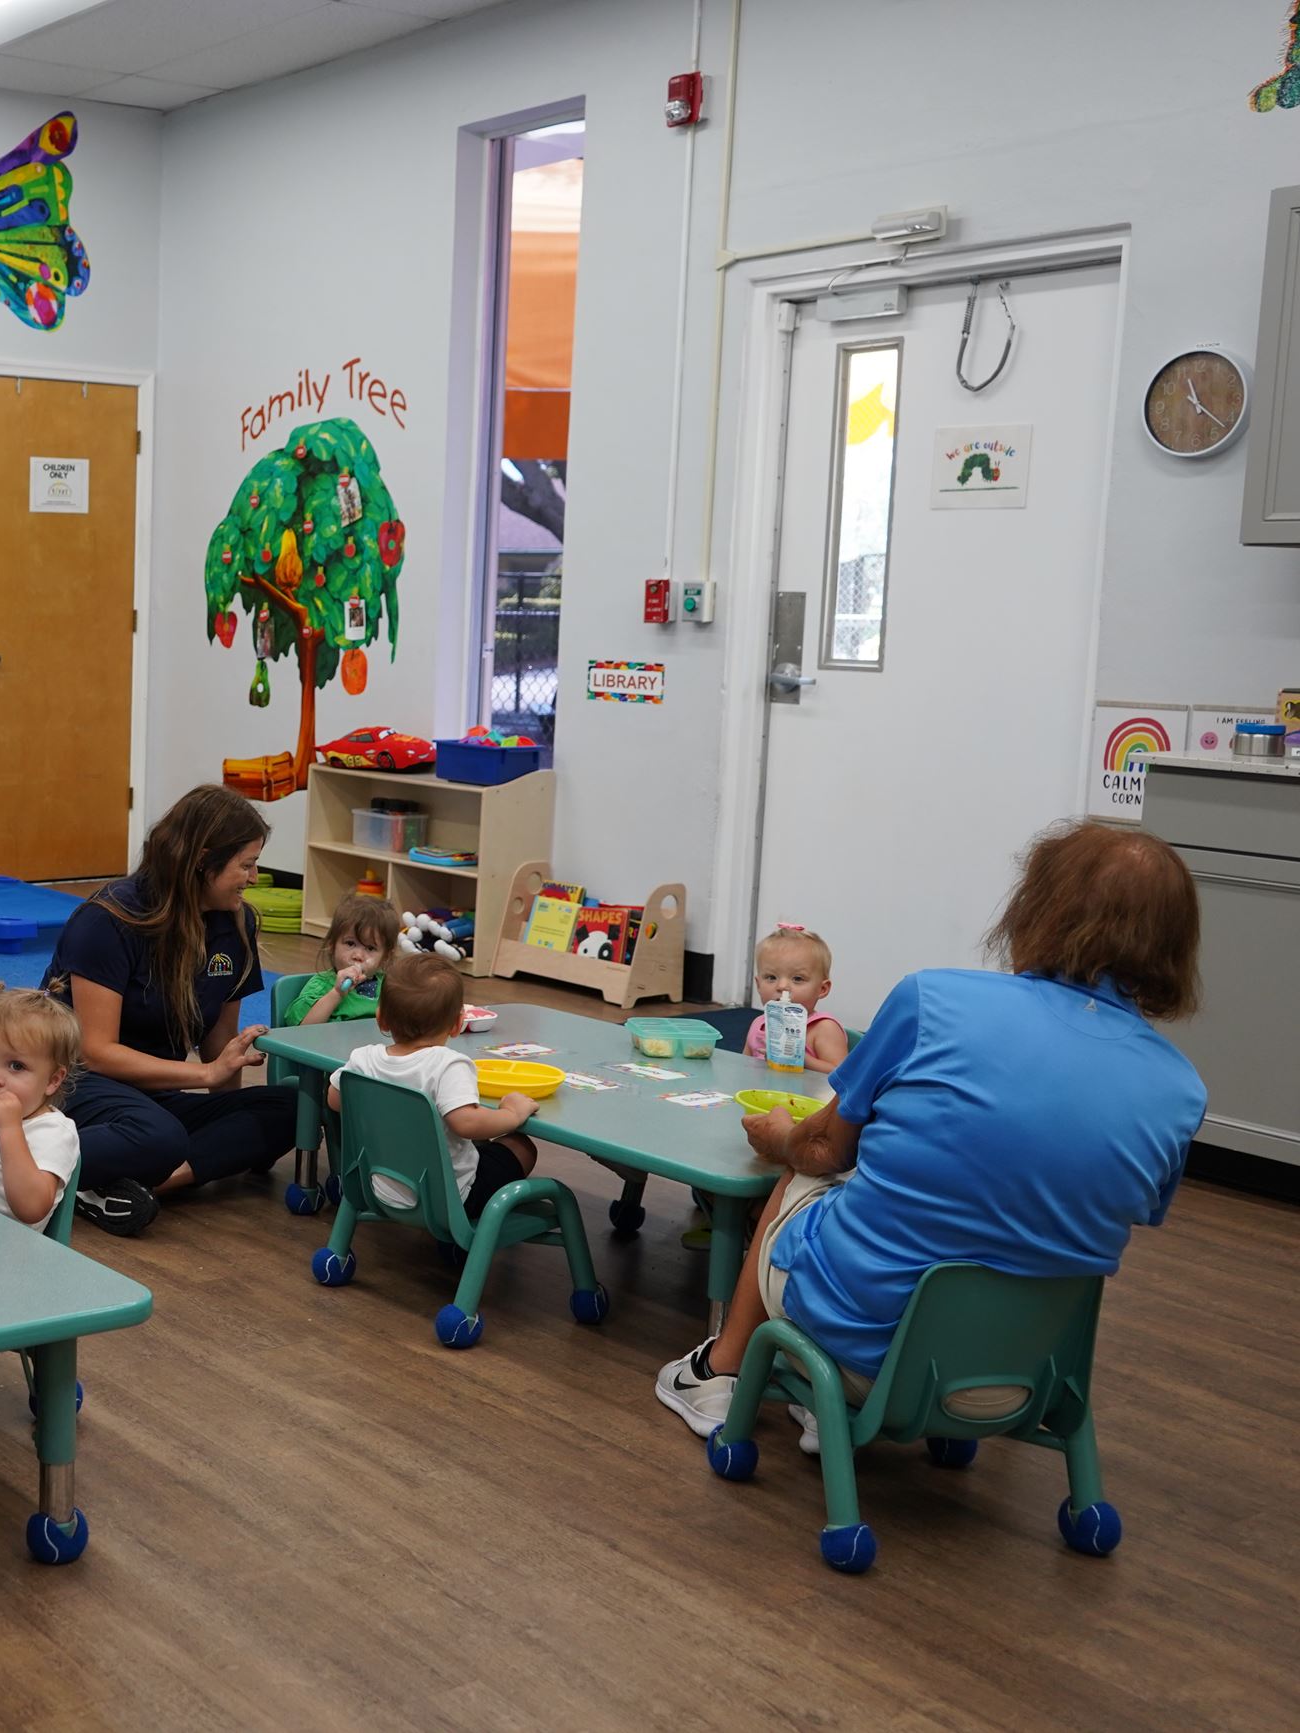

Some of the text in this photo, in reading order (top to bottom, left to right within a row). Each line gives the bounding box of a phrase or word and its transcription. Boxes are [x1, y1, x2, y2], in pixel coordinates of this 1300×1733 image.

[241, 357, 407, 452] Family Tree
[963, 441, 980, 453] are
[42, 463, 75, 472] CHILDREN
[49, 471, 68, 479] ONLY
[593, 673, 658, 690] LIBRARY
[1222, 716, 1233, 724] AM
[1103, 774, 1147, 791] CALM
[578, 909, 623, 925] SHAPES
